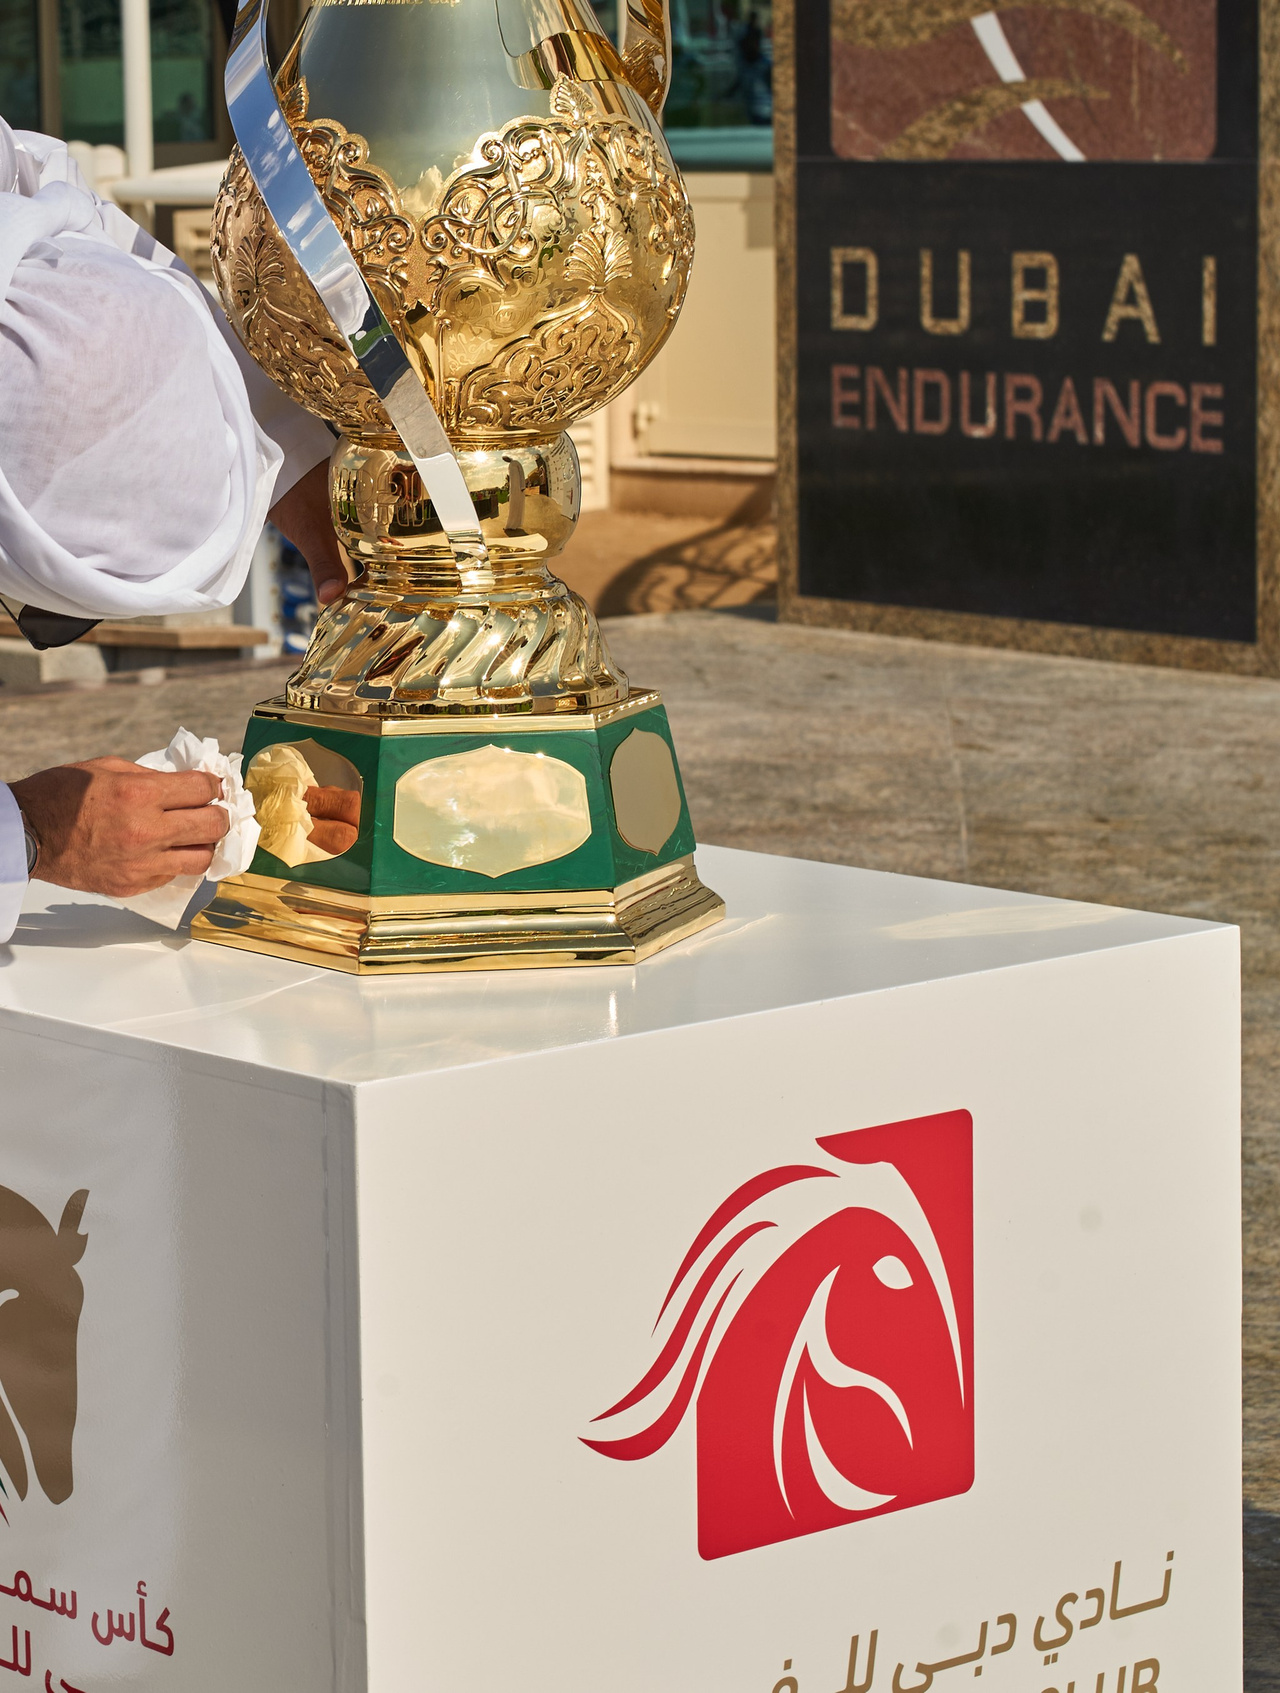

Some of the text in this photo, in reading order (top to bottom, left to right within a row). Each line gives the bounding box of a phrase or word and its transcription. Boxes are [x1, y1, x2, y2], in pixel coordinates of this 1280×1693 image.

[830, 246, 1217, 346] DUBAI
[830, 363, 1225, 455] ENDURANCE
[91, 1580, 176, 1657] كأس
[1032, 1550, 1175, 1667] نادي
